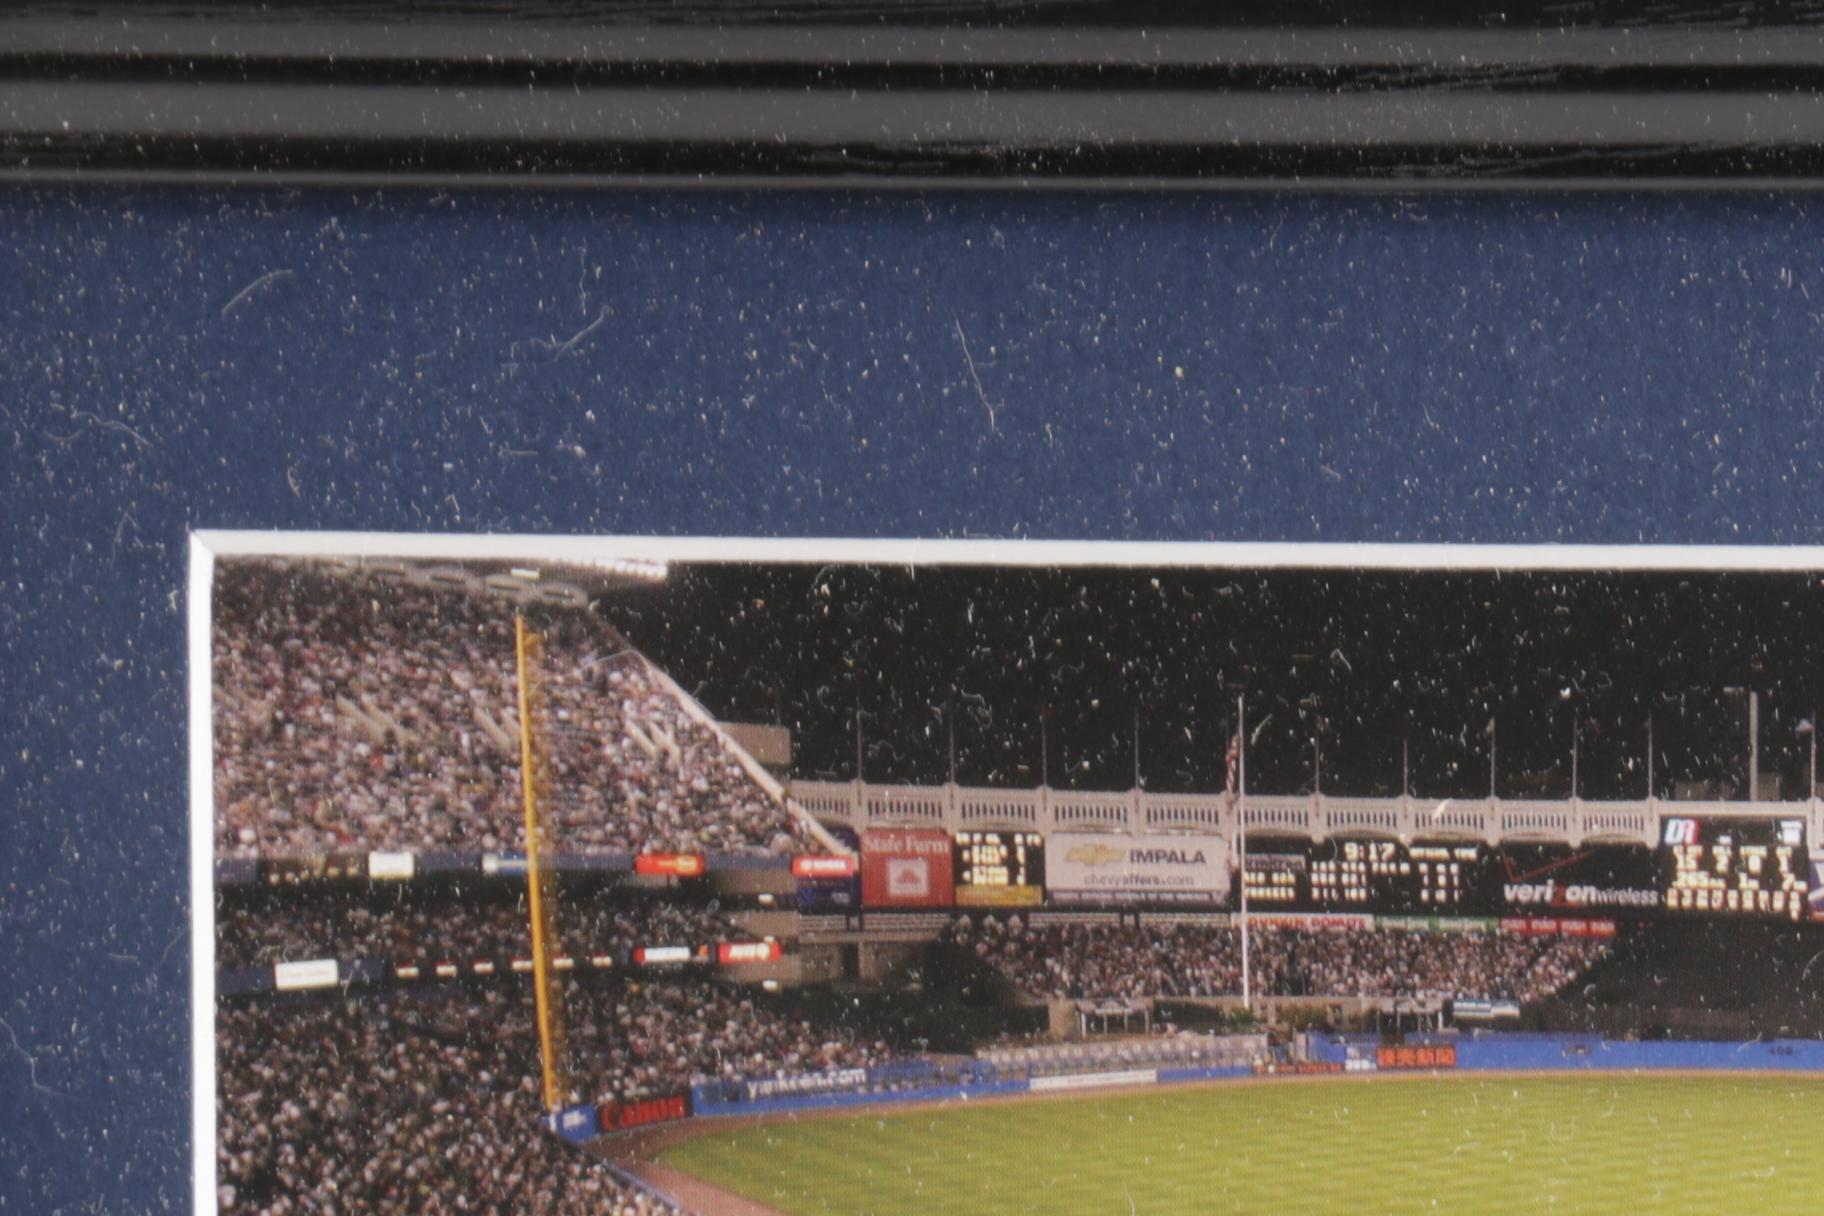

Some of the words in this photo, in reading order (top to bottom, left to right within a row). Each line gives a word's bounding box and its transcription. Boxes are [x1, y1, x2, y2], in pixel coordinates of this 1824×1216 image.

[864, 836, 901, 853] State
[905, 833, 948, 853] Farm
[1344, 842, 1395, 861] 9:17
[1130, 849, 1206, 864] IMPALA
